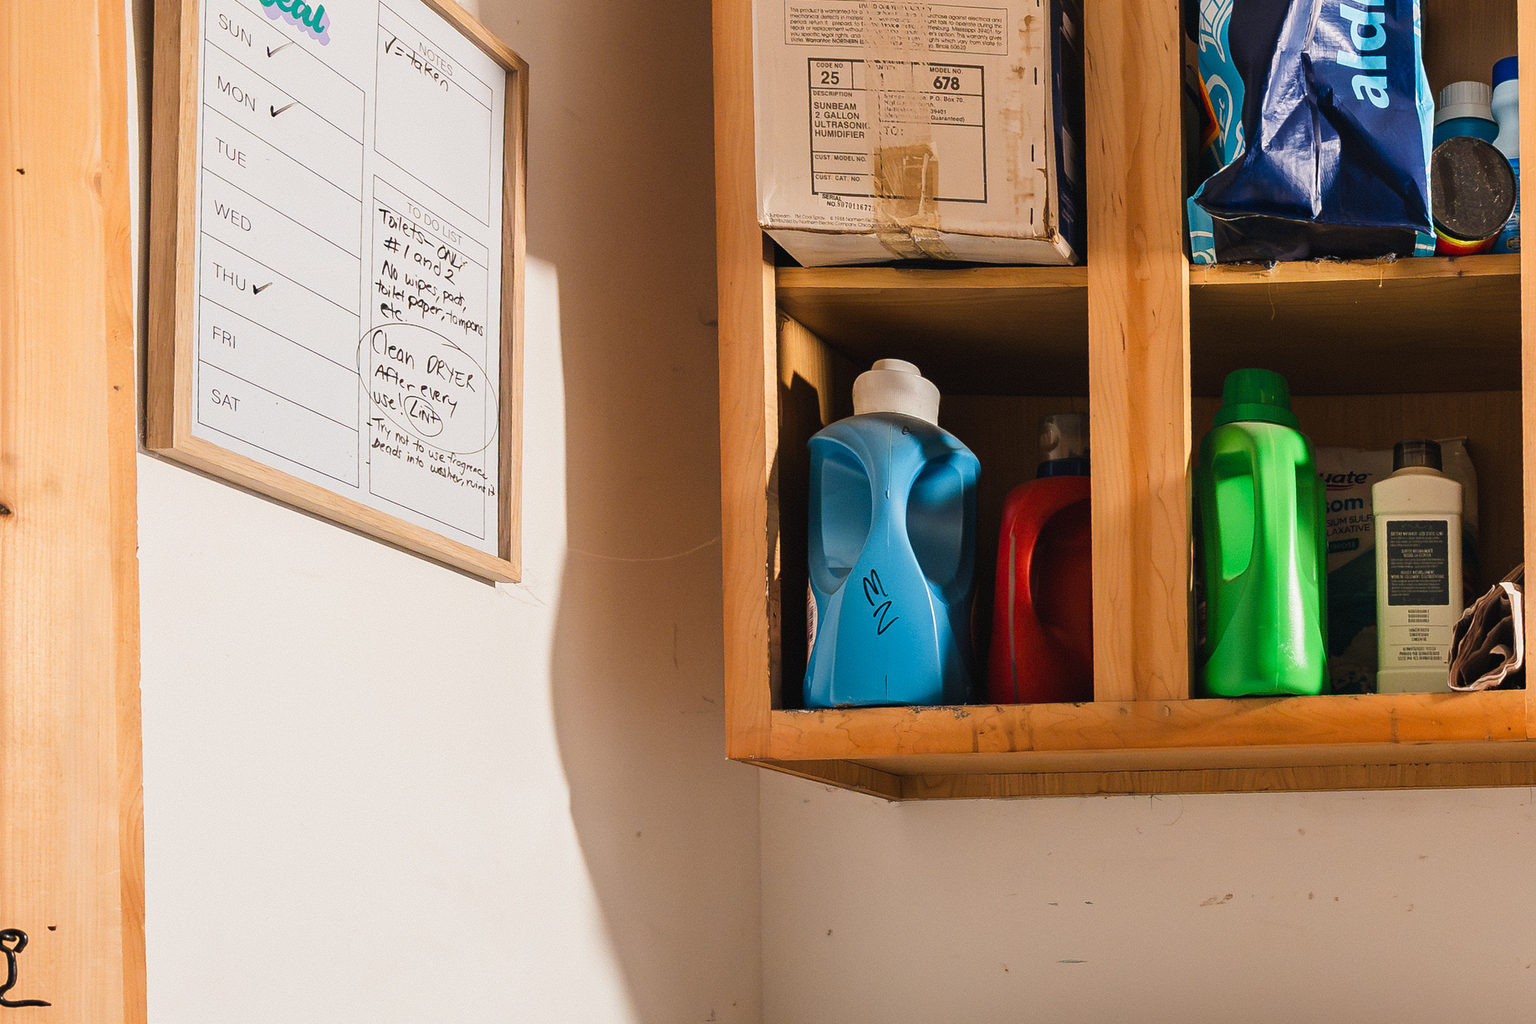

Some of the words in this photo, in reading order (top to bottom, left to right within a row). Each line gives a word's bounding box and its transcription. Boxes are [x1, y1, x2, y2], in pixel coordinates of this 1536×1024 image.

[218, 13, 252, 47] SUN
[418, 41, 453, 76] NOTES
[929, 66, 951, 74] MODEL
[820, 70, 840, 85] 25
[933, 75, 961, 91] 678
[217, 75, 256, 112] MON
[813, 101, 857, 110] SUNBEAM
[815, 111, 821, 119] 2
[823, 111, 860, 120] GALLON
[814, 129, 865, 139] HUMIDIFIER
[215, 137, 247, 169] TUE
[821, 193, 842, 202] SERIAL
[214, 200, 252, 232] WED
[406, 201, 421, 219] TO
[424, 213, 440, 232] DO
[442, 225, 463, 245] LIST
[381, 259, 398, 281] No
[413, 252, 442, 277] and
[444, 268, 456, 286] 2
[437, 245, 468, 272] ONLY
[212, 262, 246, 291] THU
[374, 278, 405, 302] toilet
[445, 309, 484, 337] tampons
[211, 325, 237, 349] FRI
[372, 329, 415, 370] Clean
[426, 354, 476, 393] DRYER
[211, 388, 241, 412] SAT
[374, 364, 416, 391] After
[420, 384, 458, 419] every
[371, 437, 402, 460] beads
[406, 451, 424, 468] into
[395, 431, 409, 446] not
[412, 439, 425, 453] to
[428, 449, 446, 463] use
[1326, 523, 1371, 537] LAXATIVE
